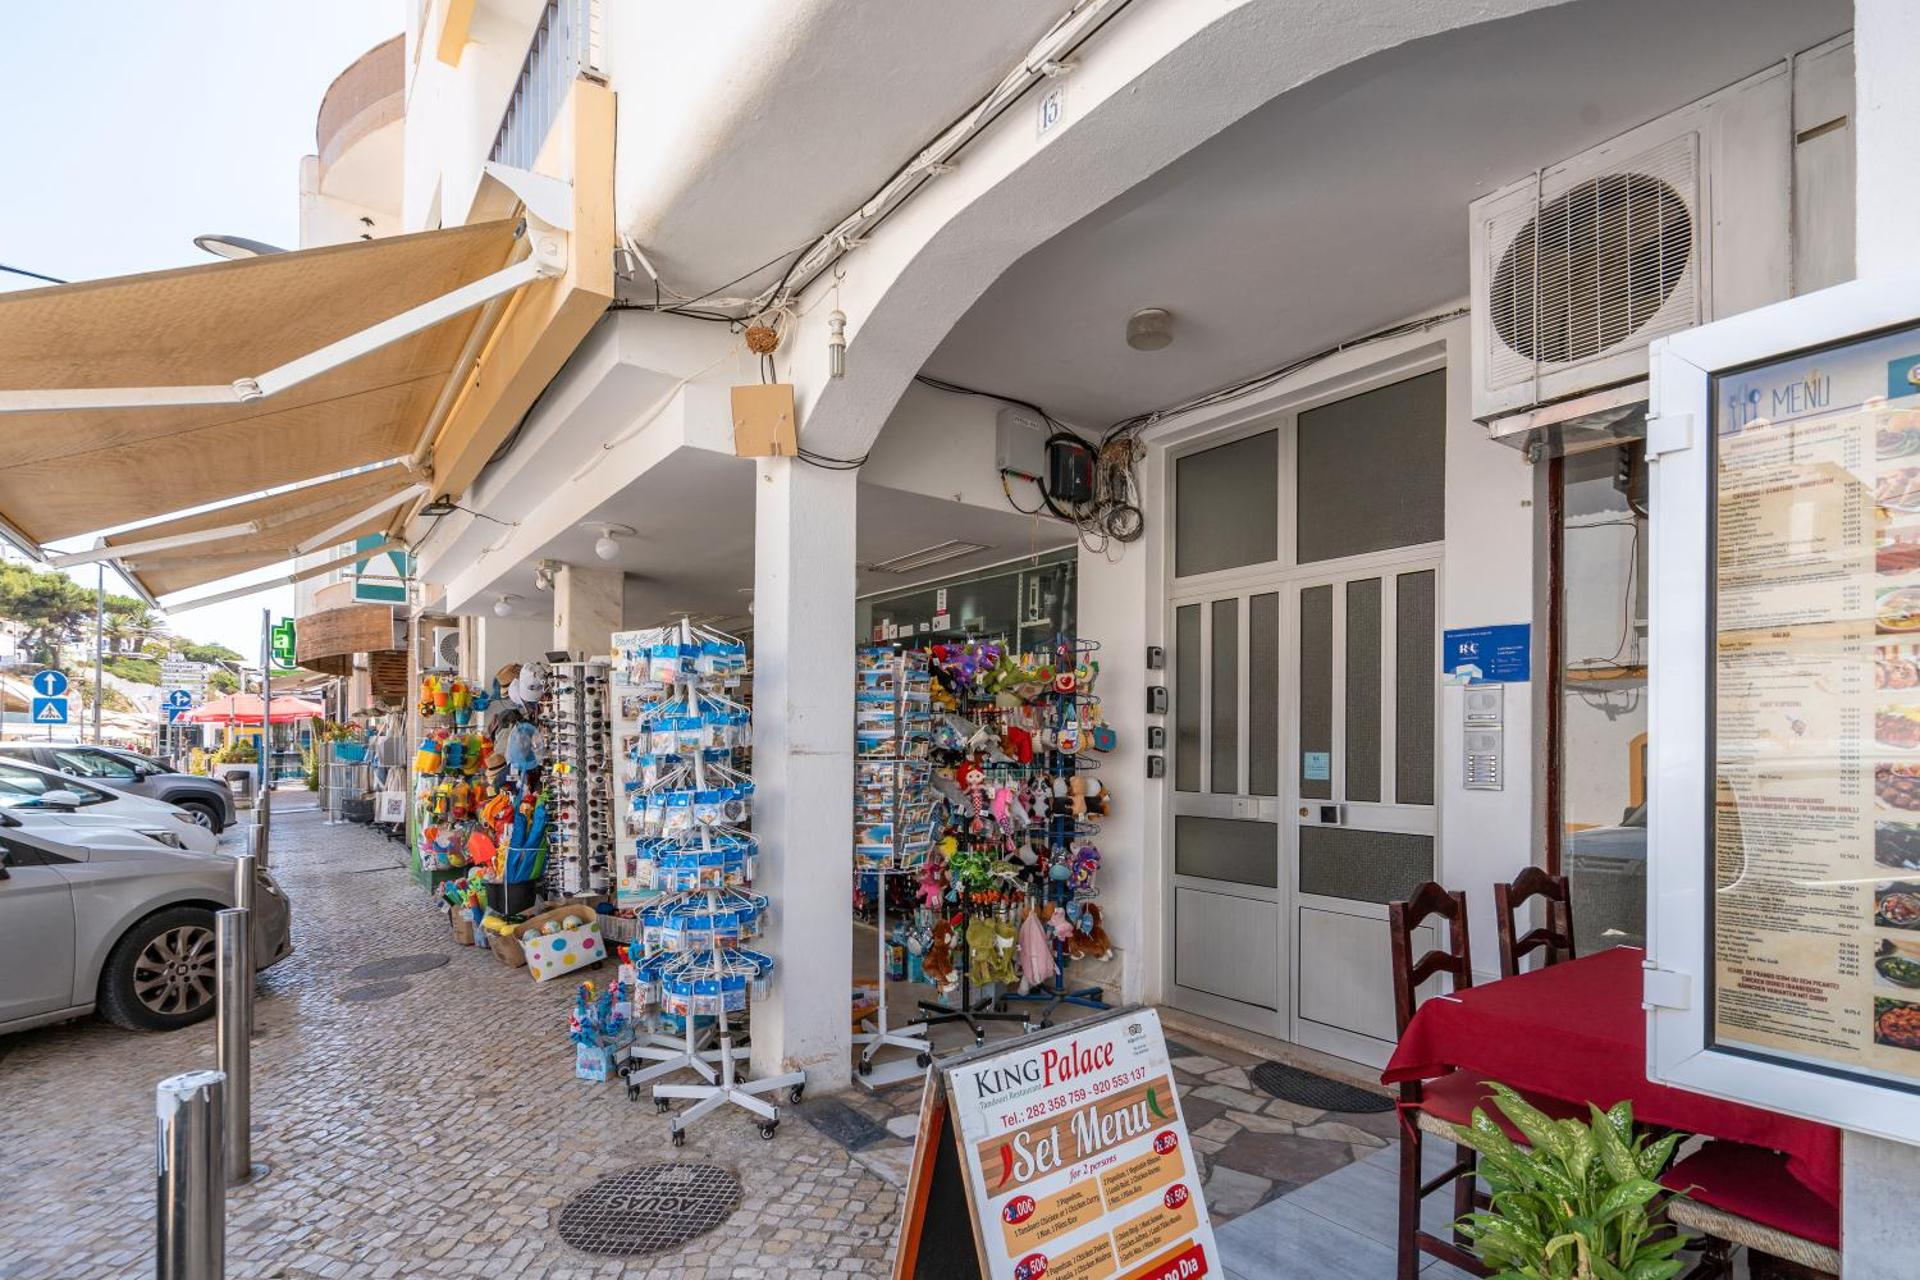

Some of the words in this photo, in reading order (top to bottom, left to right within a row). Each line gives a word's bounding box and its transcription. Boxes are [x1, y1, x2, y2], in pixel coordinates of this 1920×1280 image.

[1772, 375, 1830, 417] MENU
[974, 1059, 1040, 1098] KING
[1041, 1040, 1114, 1088] Palace
[1001, 1111, 1025, 1128] Tel.:
[1026, 1102, 1046, 1120] 282
[1048, 1096, 1067, 1112] 358
[1068, 1088, 1087, 1104] 759
[1092, 1080, 1111, 1095] 920
[1112, 1073, 1129, 1088] 553
[1130, 1066, 1146, 1083] 137
[1012, 1125, 1062, 1182] Set
[1071, 1100, 1152, 1158] Menu
[1069, 1167, 1080, 1184] for
[1083, 1165, 1088, 1175] 2
[1089, 1154, 1117, 1175] persons
